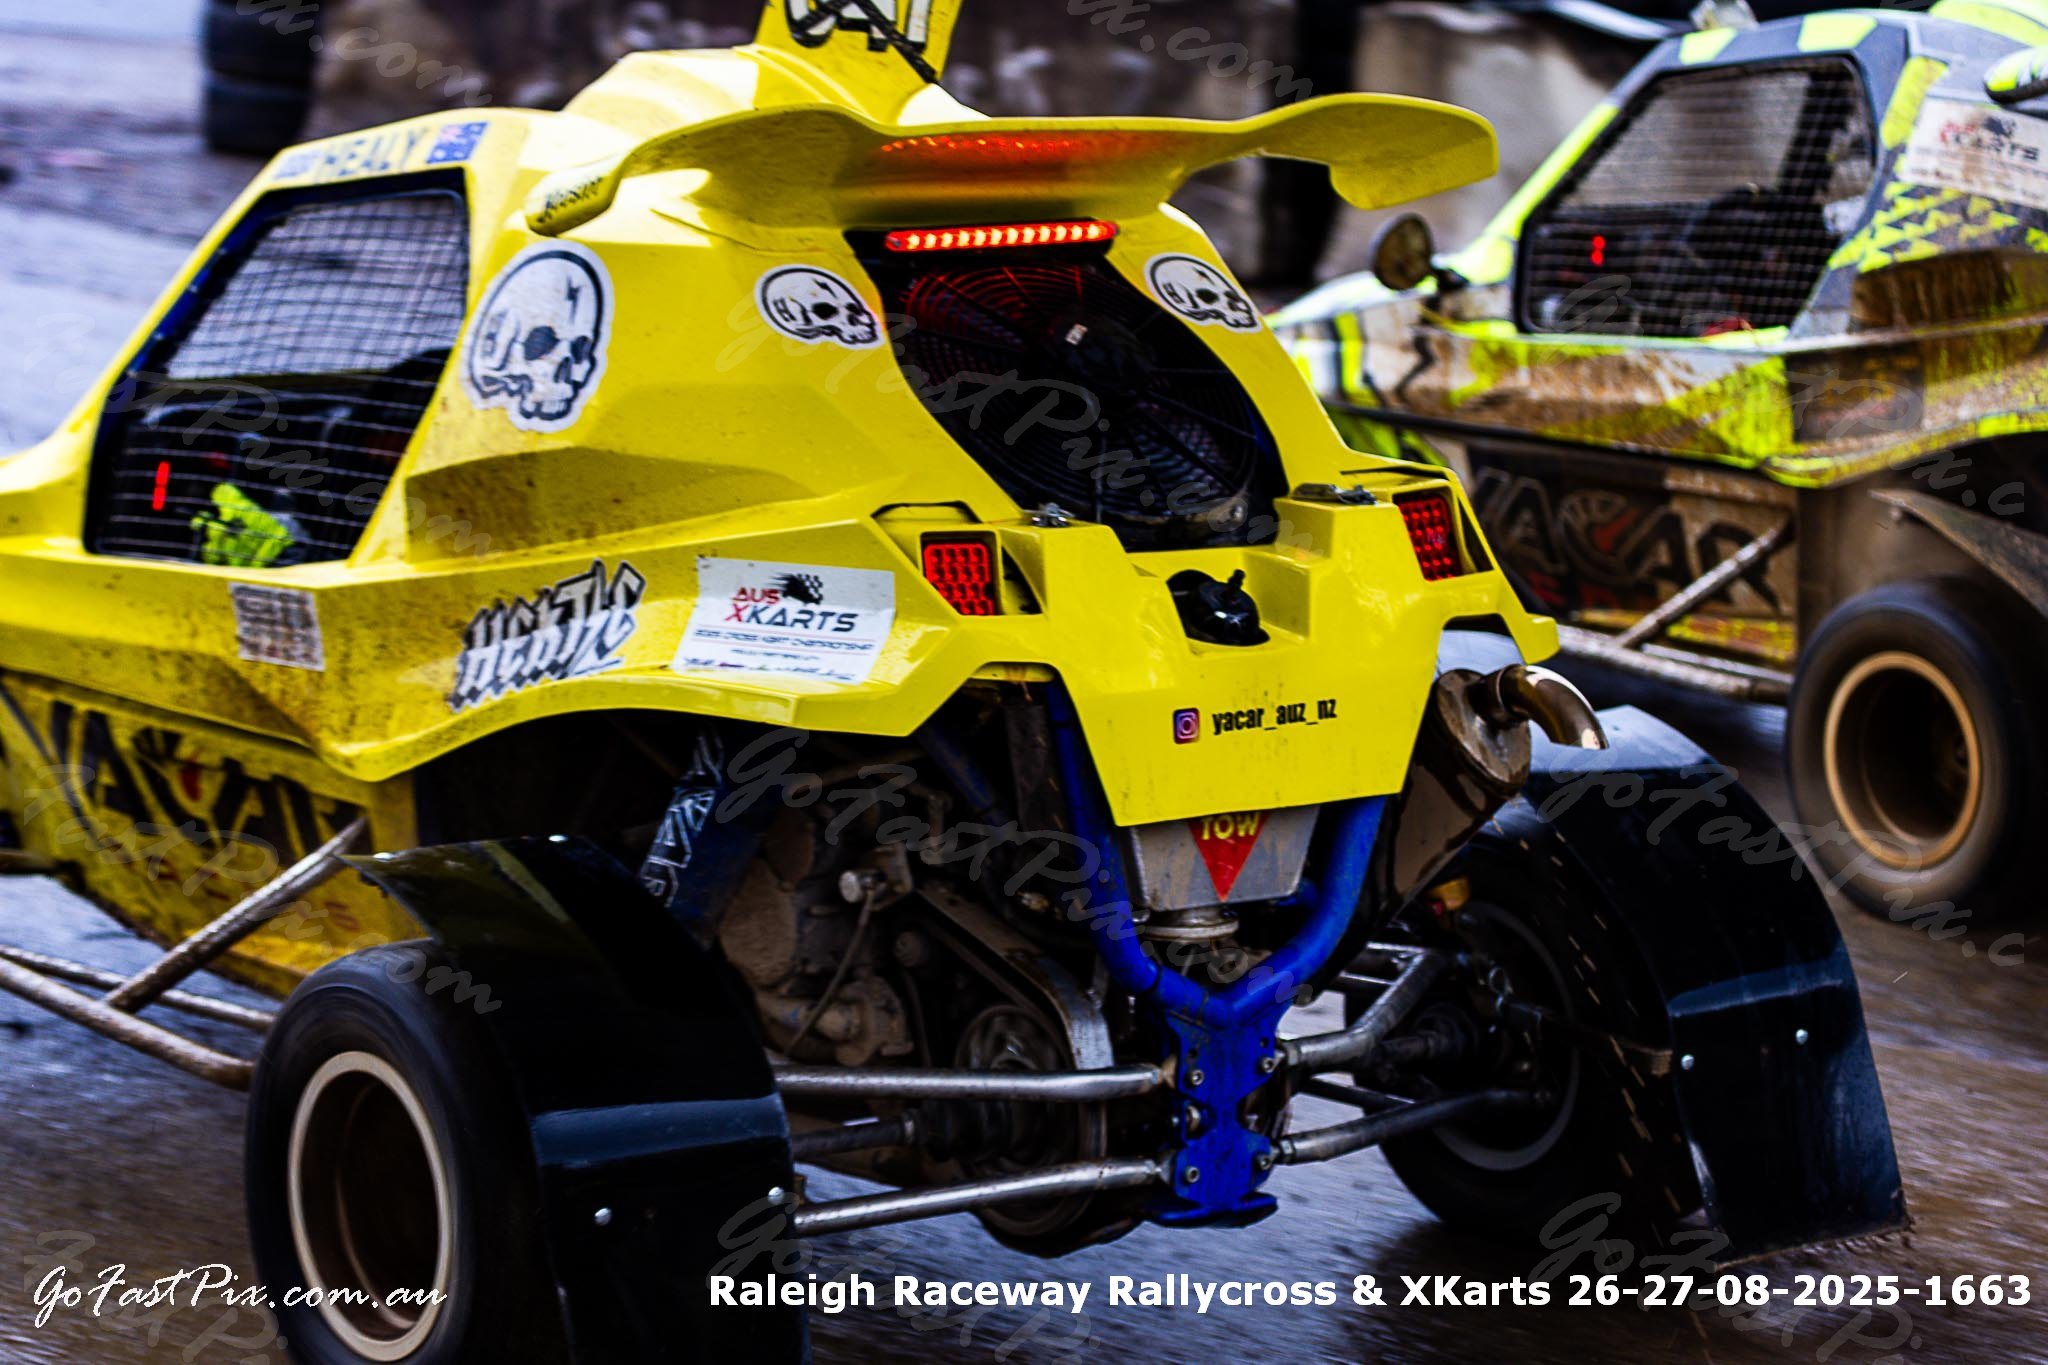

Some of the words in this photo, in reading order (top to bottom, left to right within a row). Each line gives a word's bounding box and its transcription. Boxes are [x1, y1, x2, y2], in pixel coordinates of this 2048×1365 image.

[731, 587, 780, 605] AUS
[724, 603, 859, 633] XKARTS
[1212, 699, 1338, 735] yacar_auz_nz
[1201, 811, 1261, 841] TOW
